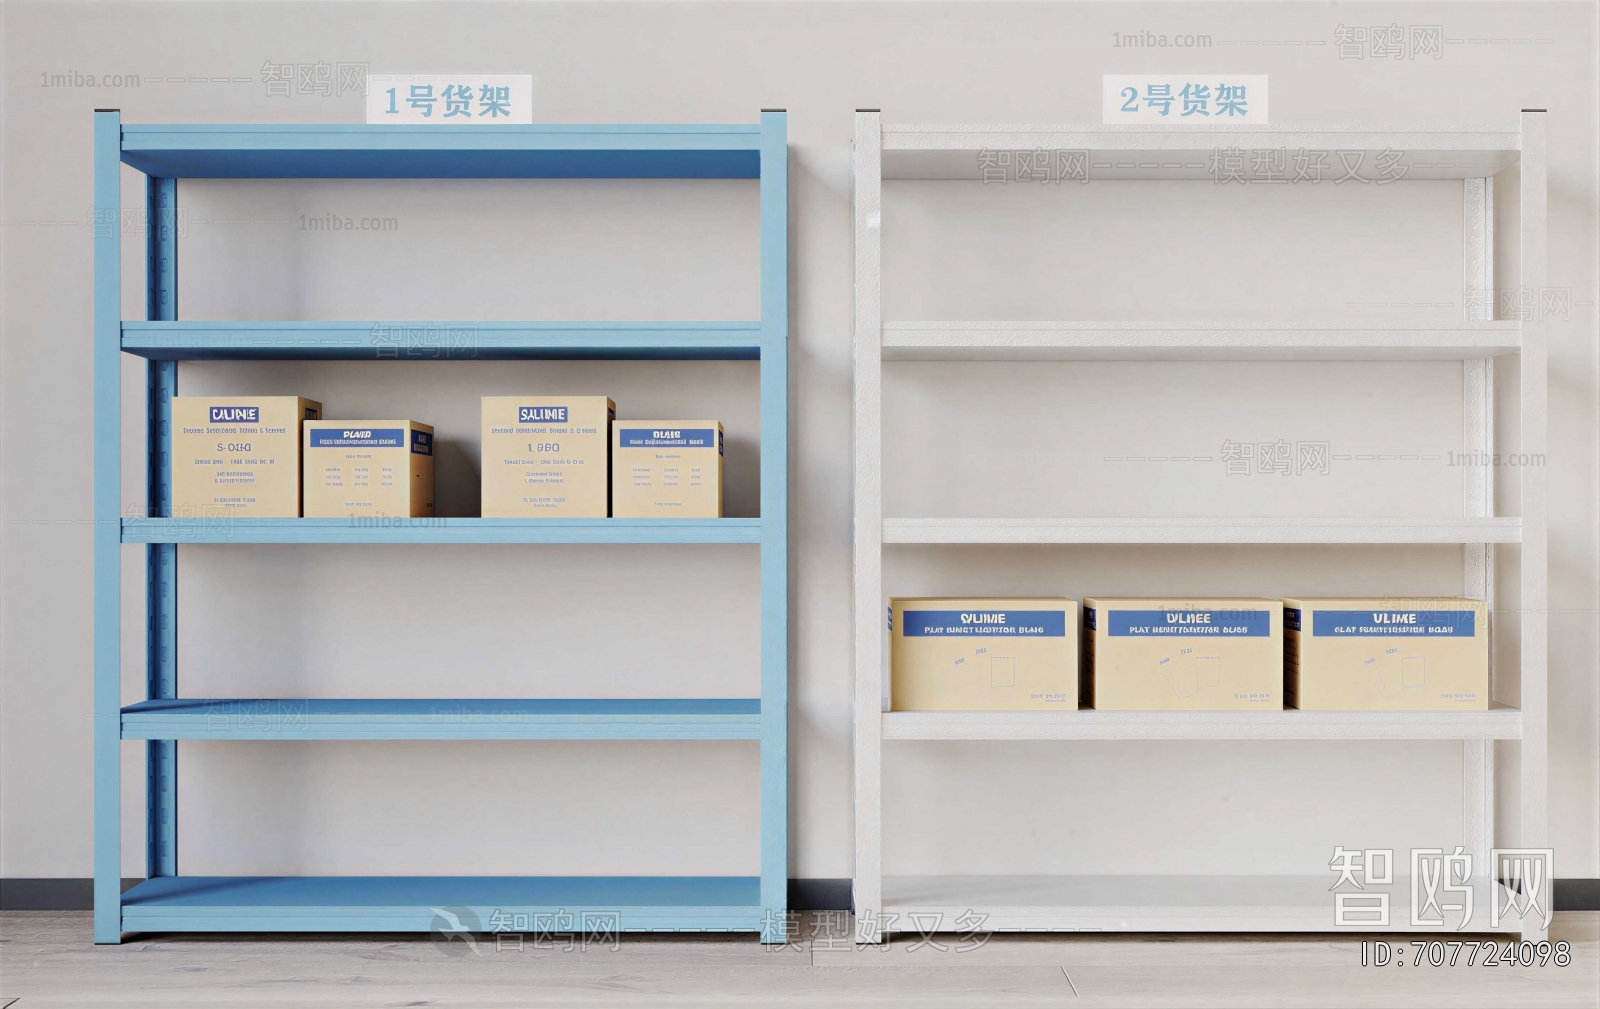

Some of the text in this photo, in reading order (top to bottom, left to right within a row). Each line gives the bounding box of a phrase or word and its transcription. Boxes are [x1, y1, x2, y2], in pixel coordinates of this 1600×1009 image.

[385, 84, 512, 118] 1号货架
[1120, 84, 1249, 118] 2号货架
